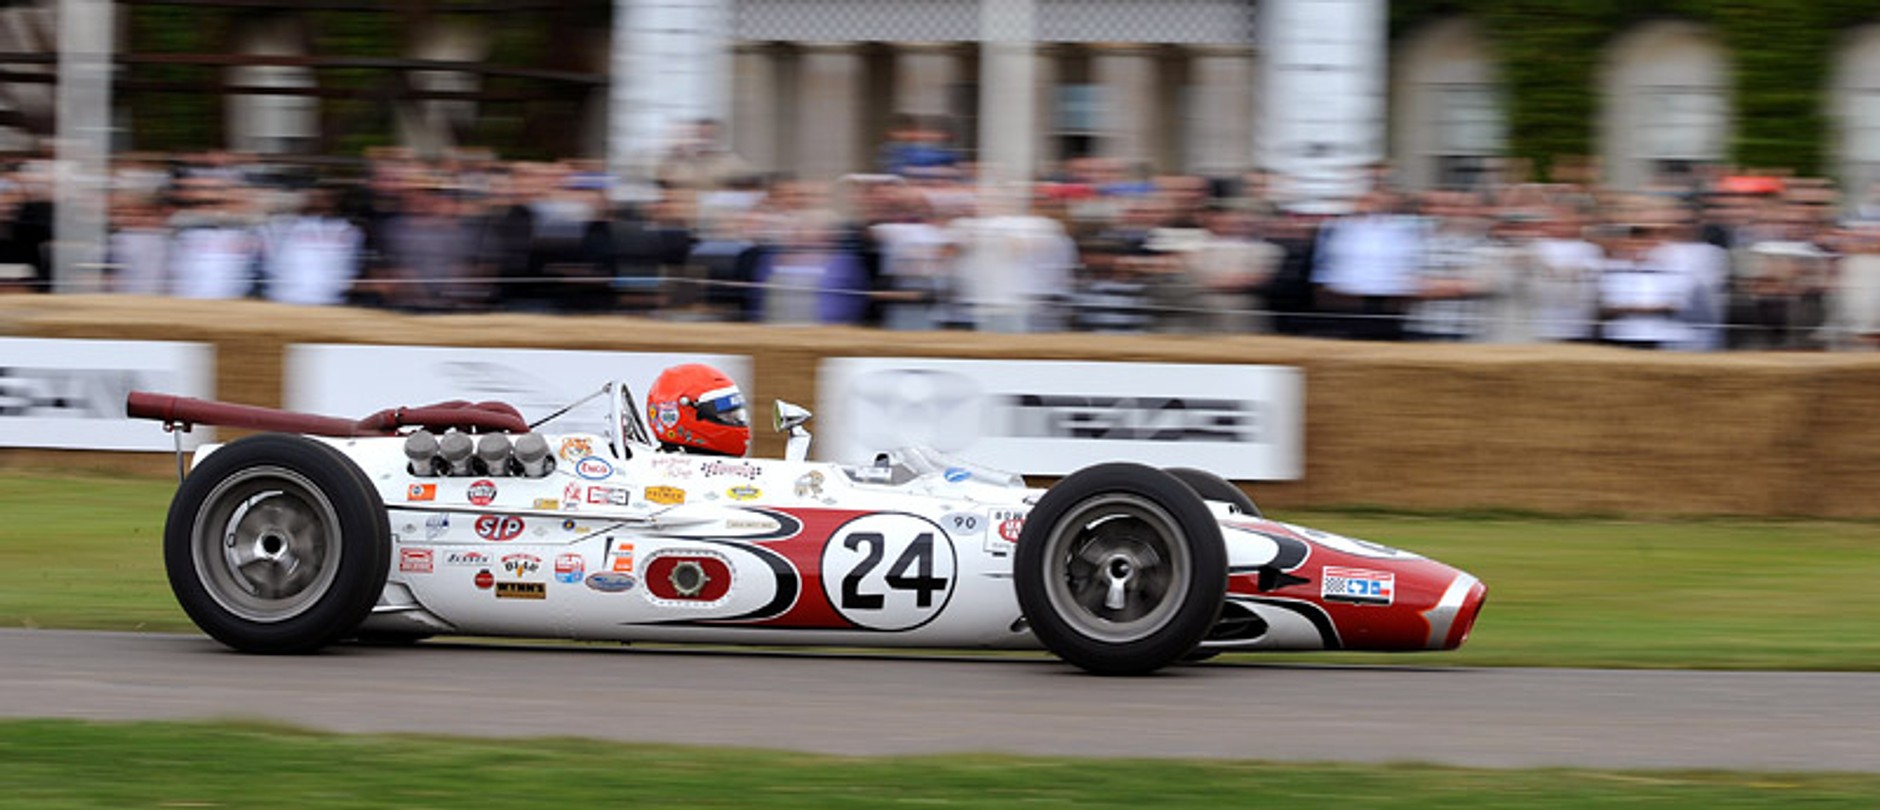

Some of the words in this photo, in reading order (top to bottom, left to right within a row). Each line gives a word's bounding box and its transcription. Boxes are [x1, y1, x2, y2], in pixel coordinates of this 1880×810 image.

[479, 515, 521, 541] STP
[954, 516, 977, 530] 90
[841, 532, 948, 610] 24
